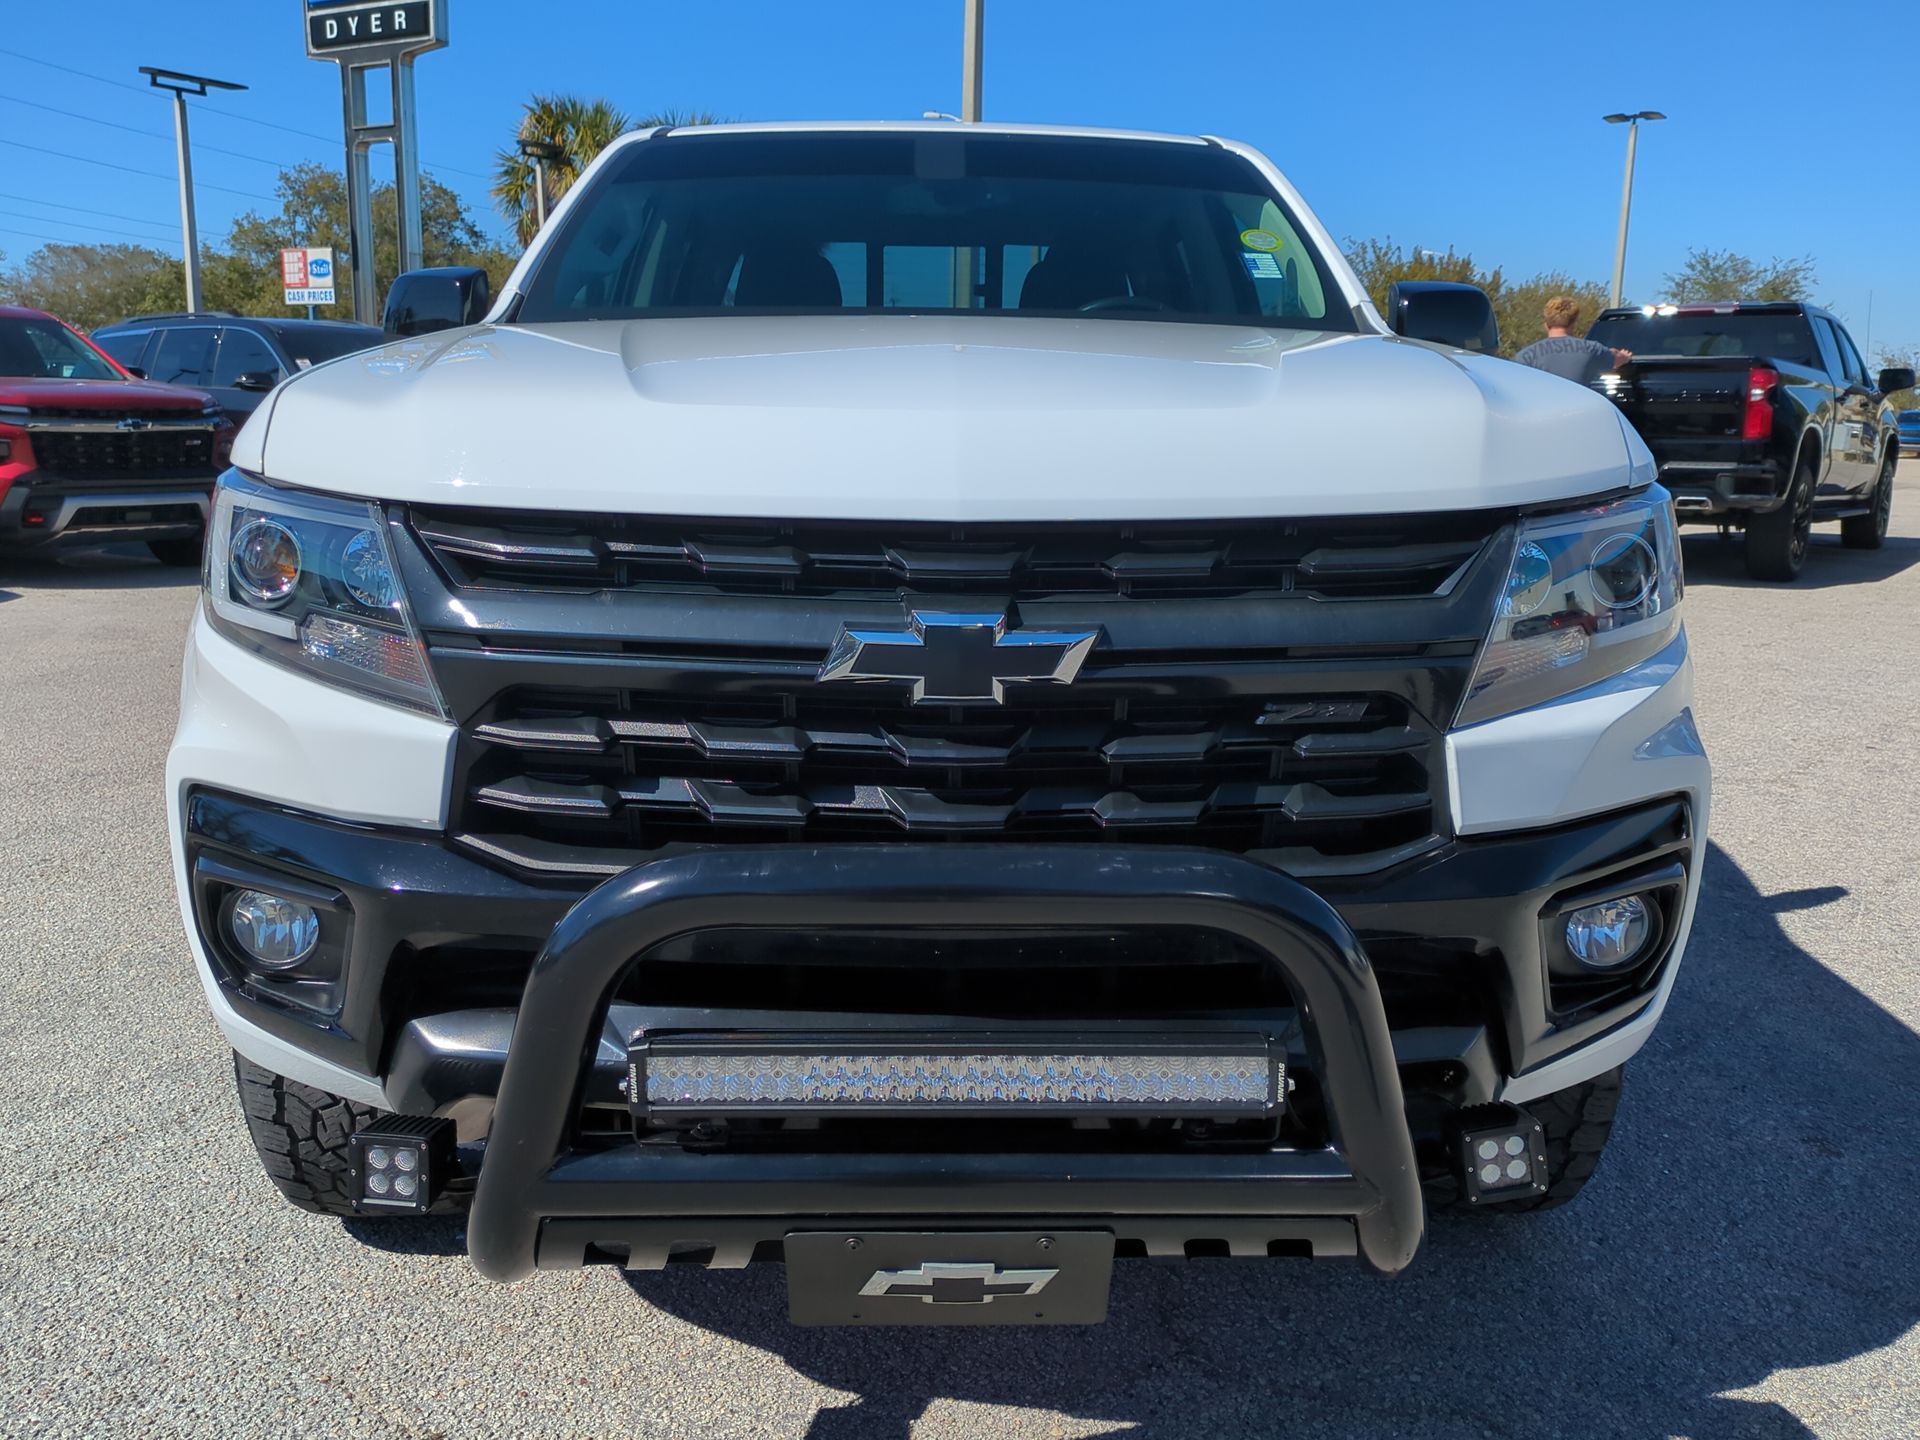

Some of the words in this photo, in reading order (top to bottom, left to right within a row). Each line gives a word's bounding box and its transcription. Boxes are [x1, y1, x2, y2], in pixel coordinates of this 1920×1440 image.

[325, 9, 407, 39] DYER
[287, 290, 305, 302] CASH
[307, 290, 333, 301] PRICES
[629, 1063, 638, 1104] SYLVANIA
[1277, 1062, 1286, 1103] SYLVANIA
